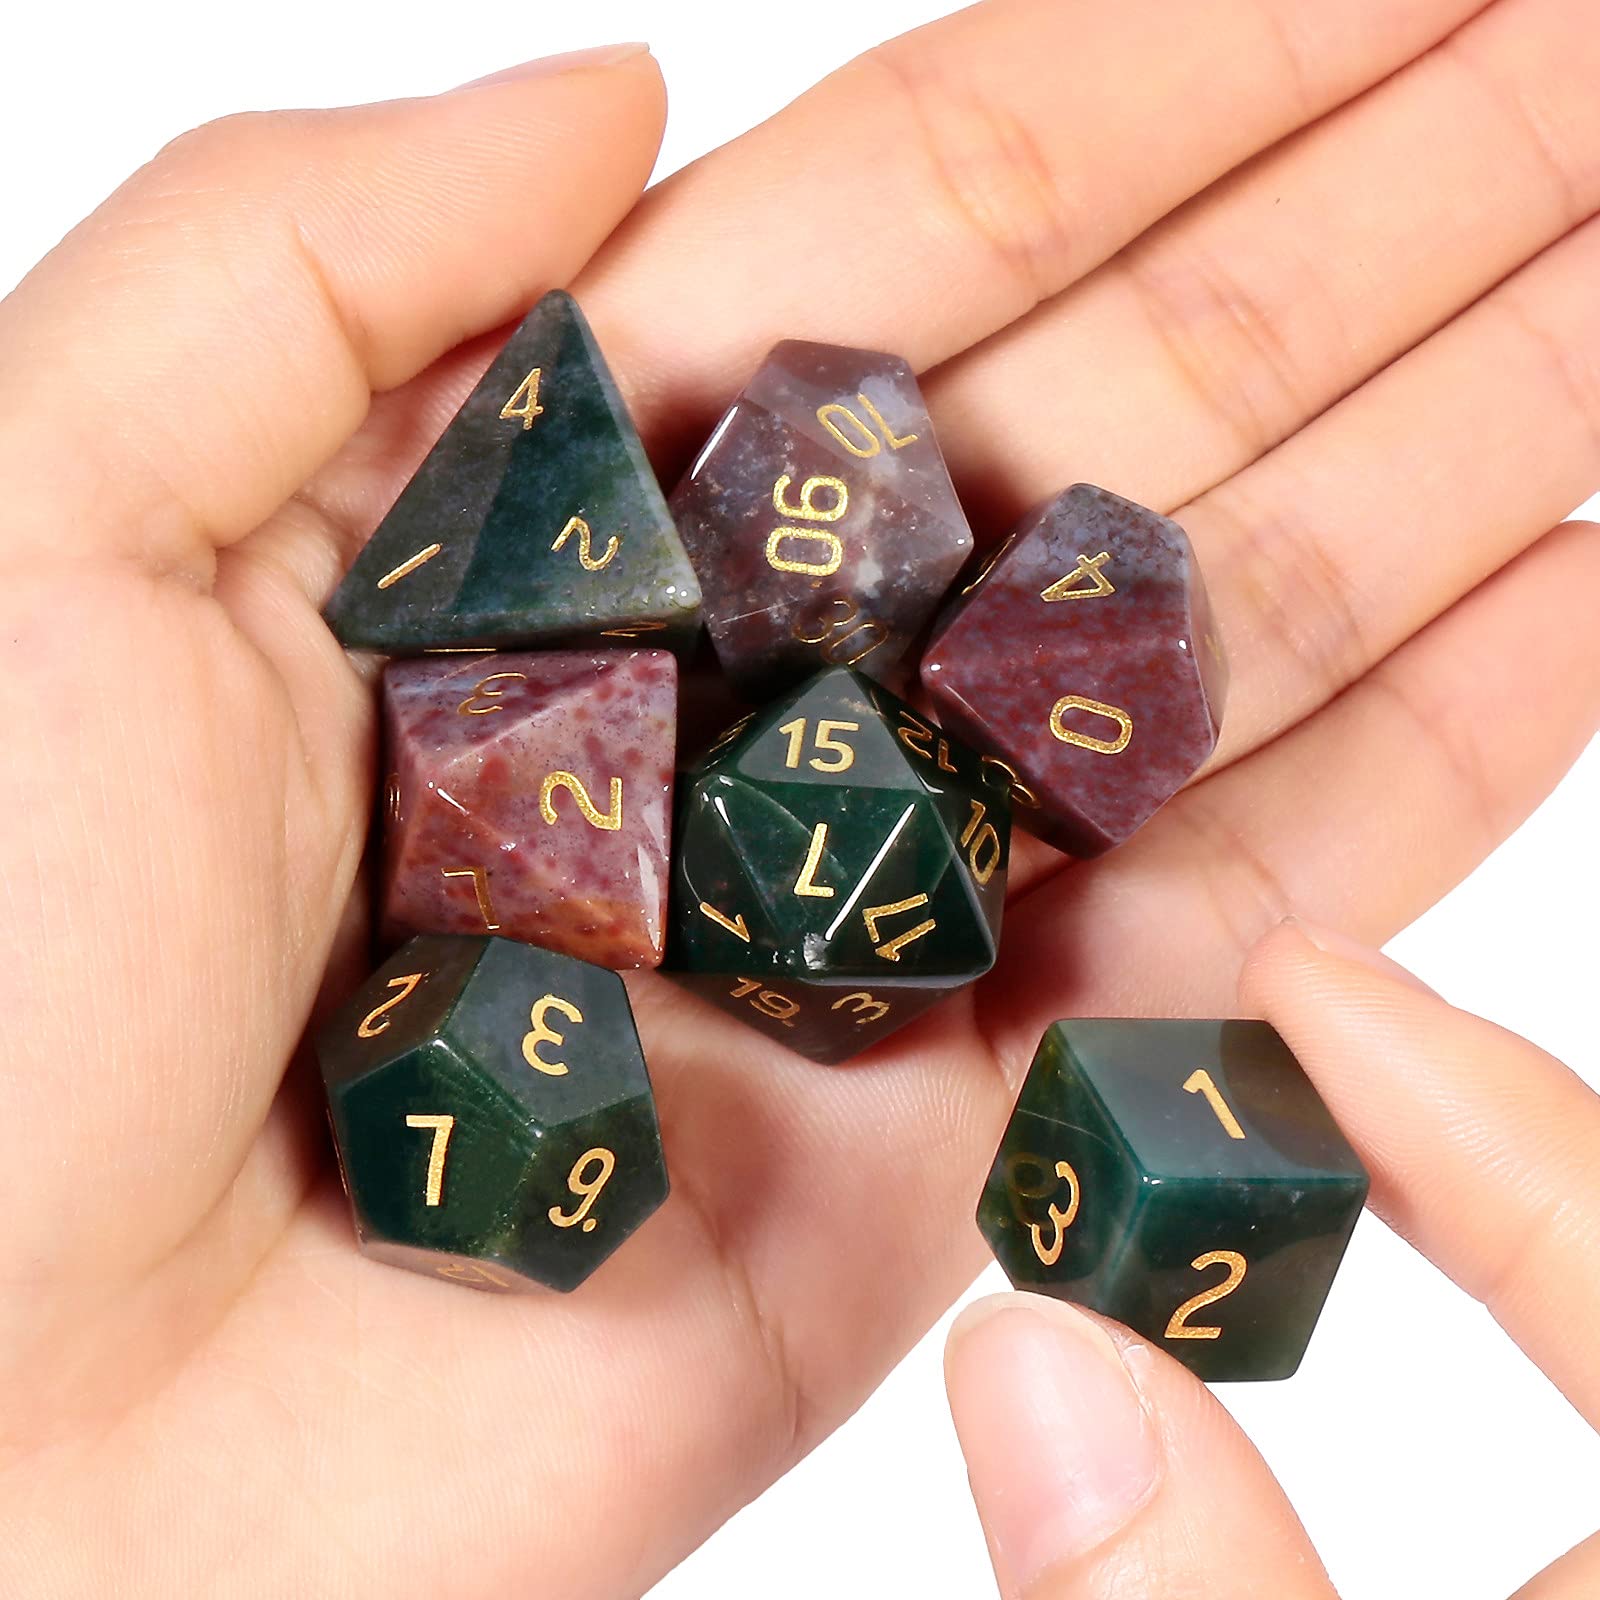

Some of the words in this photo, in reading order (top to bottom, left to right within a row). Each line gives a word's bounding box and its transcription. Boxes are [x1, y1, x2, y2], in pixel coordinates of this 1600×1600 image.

[499, 366, 544, 431] 4
[816, 392, 919, 458] 70
[551, 515, 620, 572] 2
[1039, 550, 1115, 603] 4
[456, 671, 528, 716] 3
[778, 717, 861, 774] 15
[538, 770, 623, 831] 2
[794, 822, 835, 897] 7
[961, 799, 999, 885] 10
[440, 865, 501, 930] 7
[699, 902, 751, 943] 1
[861, 892, 937, 962] 17
[356, 972, 423, 1039] 2
[521, 992, 584, 1077] 3
[831, 991, 891, 1025] 3
[1182, 1067, 1247, 1140] 1
[405, 1113, 455, 1207] 7
[1030, 1160, 1081, 1266] 3
[1163, 1249, 1249, 1340] 2
